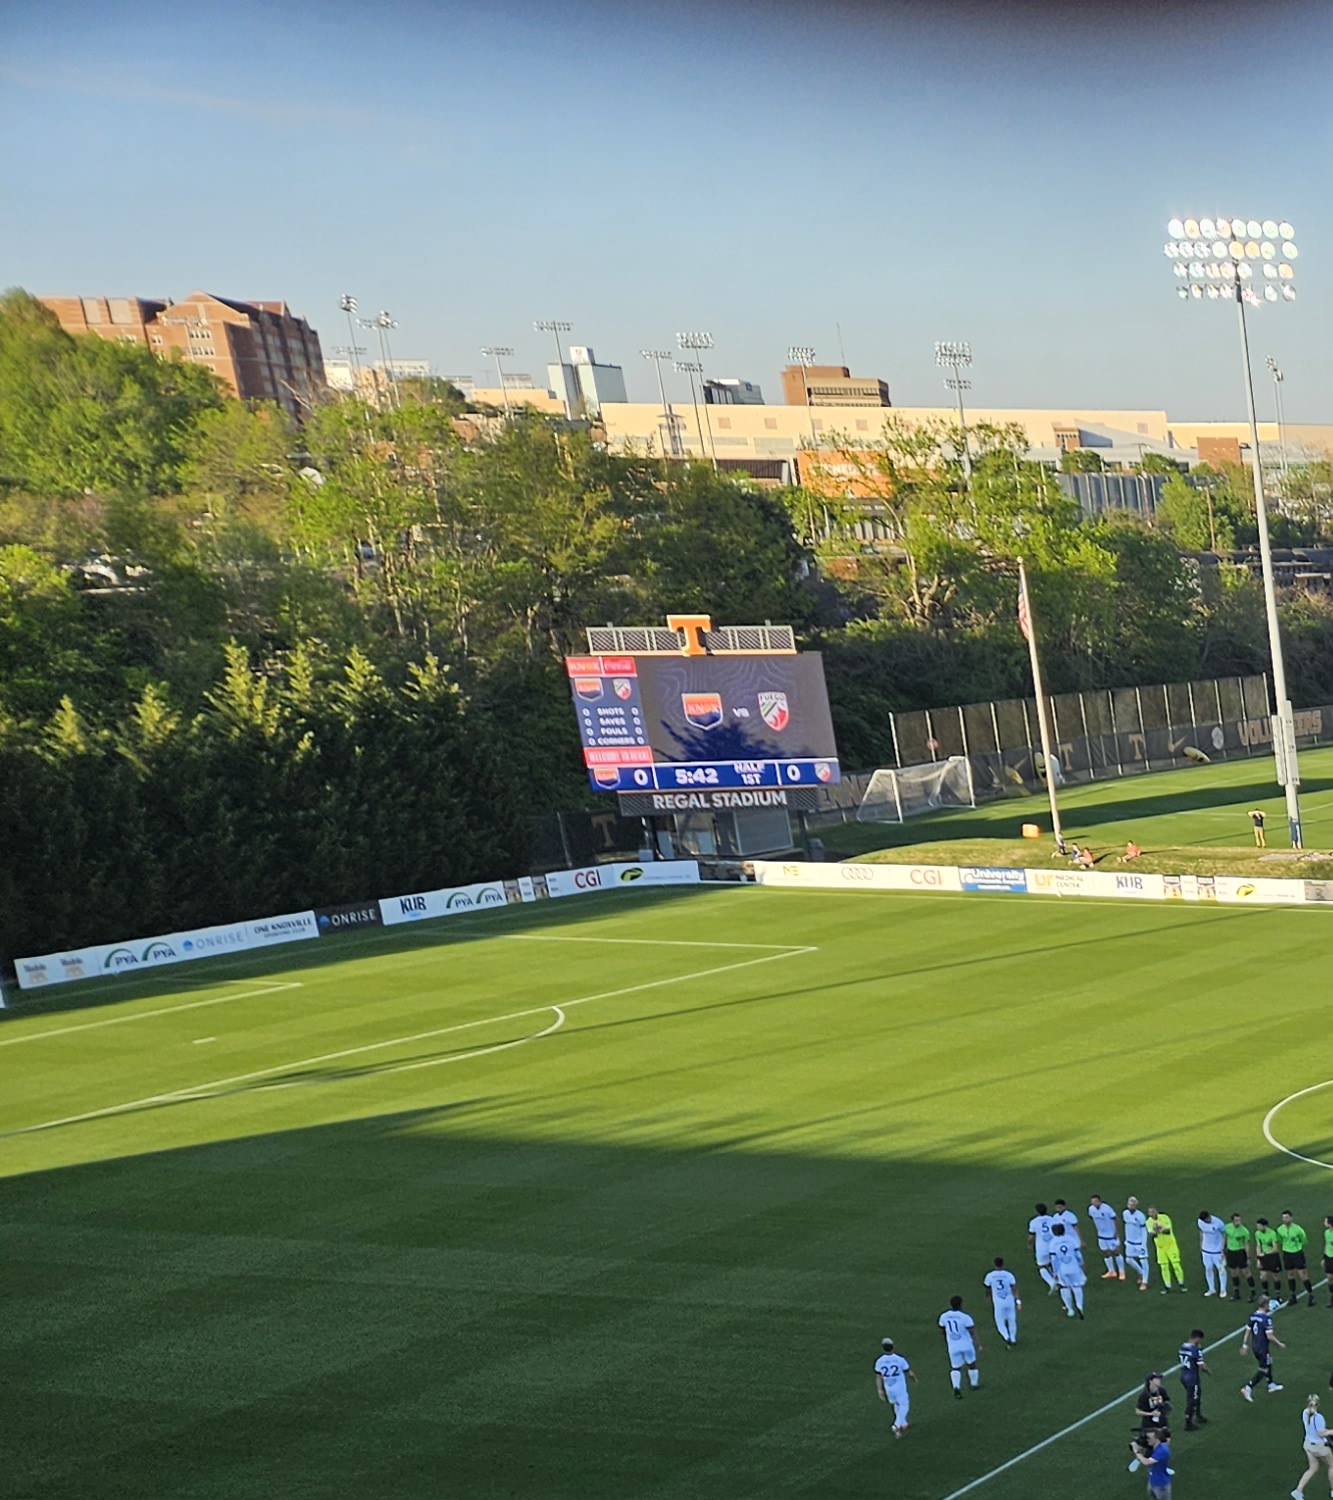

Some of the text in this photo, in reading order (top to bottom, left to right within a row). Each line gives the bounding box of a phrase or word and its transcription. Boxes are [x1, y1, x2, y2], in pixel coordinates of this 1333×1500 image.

[667, 615, 711, 656] T
[597, 707, 625, 715] SHOTS
[599, 717, 626, 725] SAVES
[600, 727, 628, 735] FOULS
[597, 737, 636, 745] CORNERS
[634, 769, 648, 786] 0
[675, 768, 719, 784] 5:42
[741, 773, 761, 785] 1ST
[787, 764, 801, 781] 0
[653, 790, 788, 809] REGAL STADIUM
[575, 870, 601, 888] CGI
[910, 869, 942, 885] CGI
[1116, 876, 1143, 889] KUB
[400, 896, 426, 914] KUB
[455, 898, 473, 908] PYA
[485, 894, 504, 903] PYA
[331, 908, 377, 926] ONRISE
[196, 932, 244, 949] ONRISE
[115, 955, 139, 966] PYA
[153, 948, 177, 960] PYA
[1042, 1222, 1050, 1233] 5
[1060, 1245, 1068, 1256] 9
[996, 1279, 1005, 1291] 3
[947, 1320, 959, 1333] 11
[880, 1365, 900, 1378] 22
